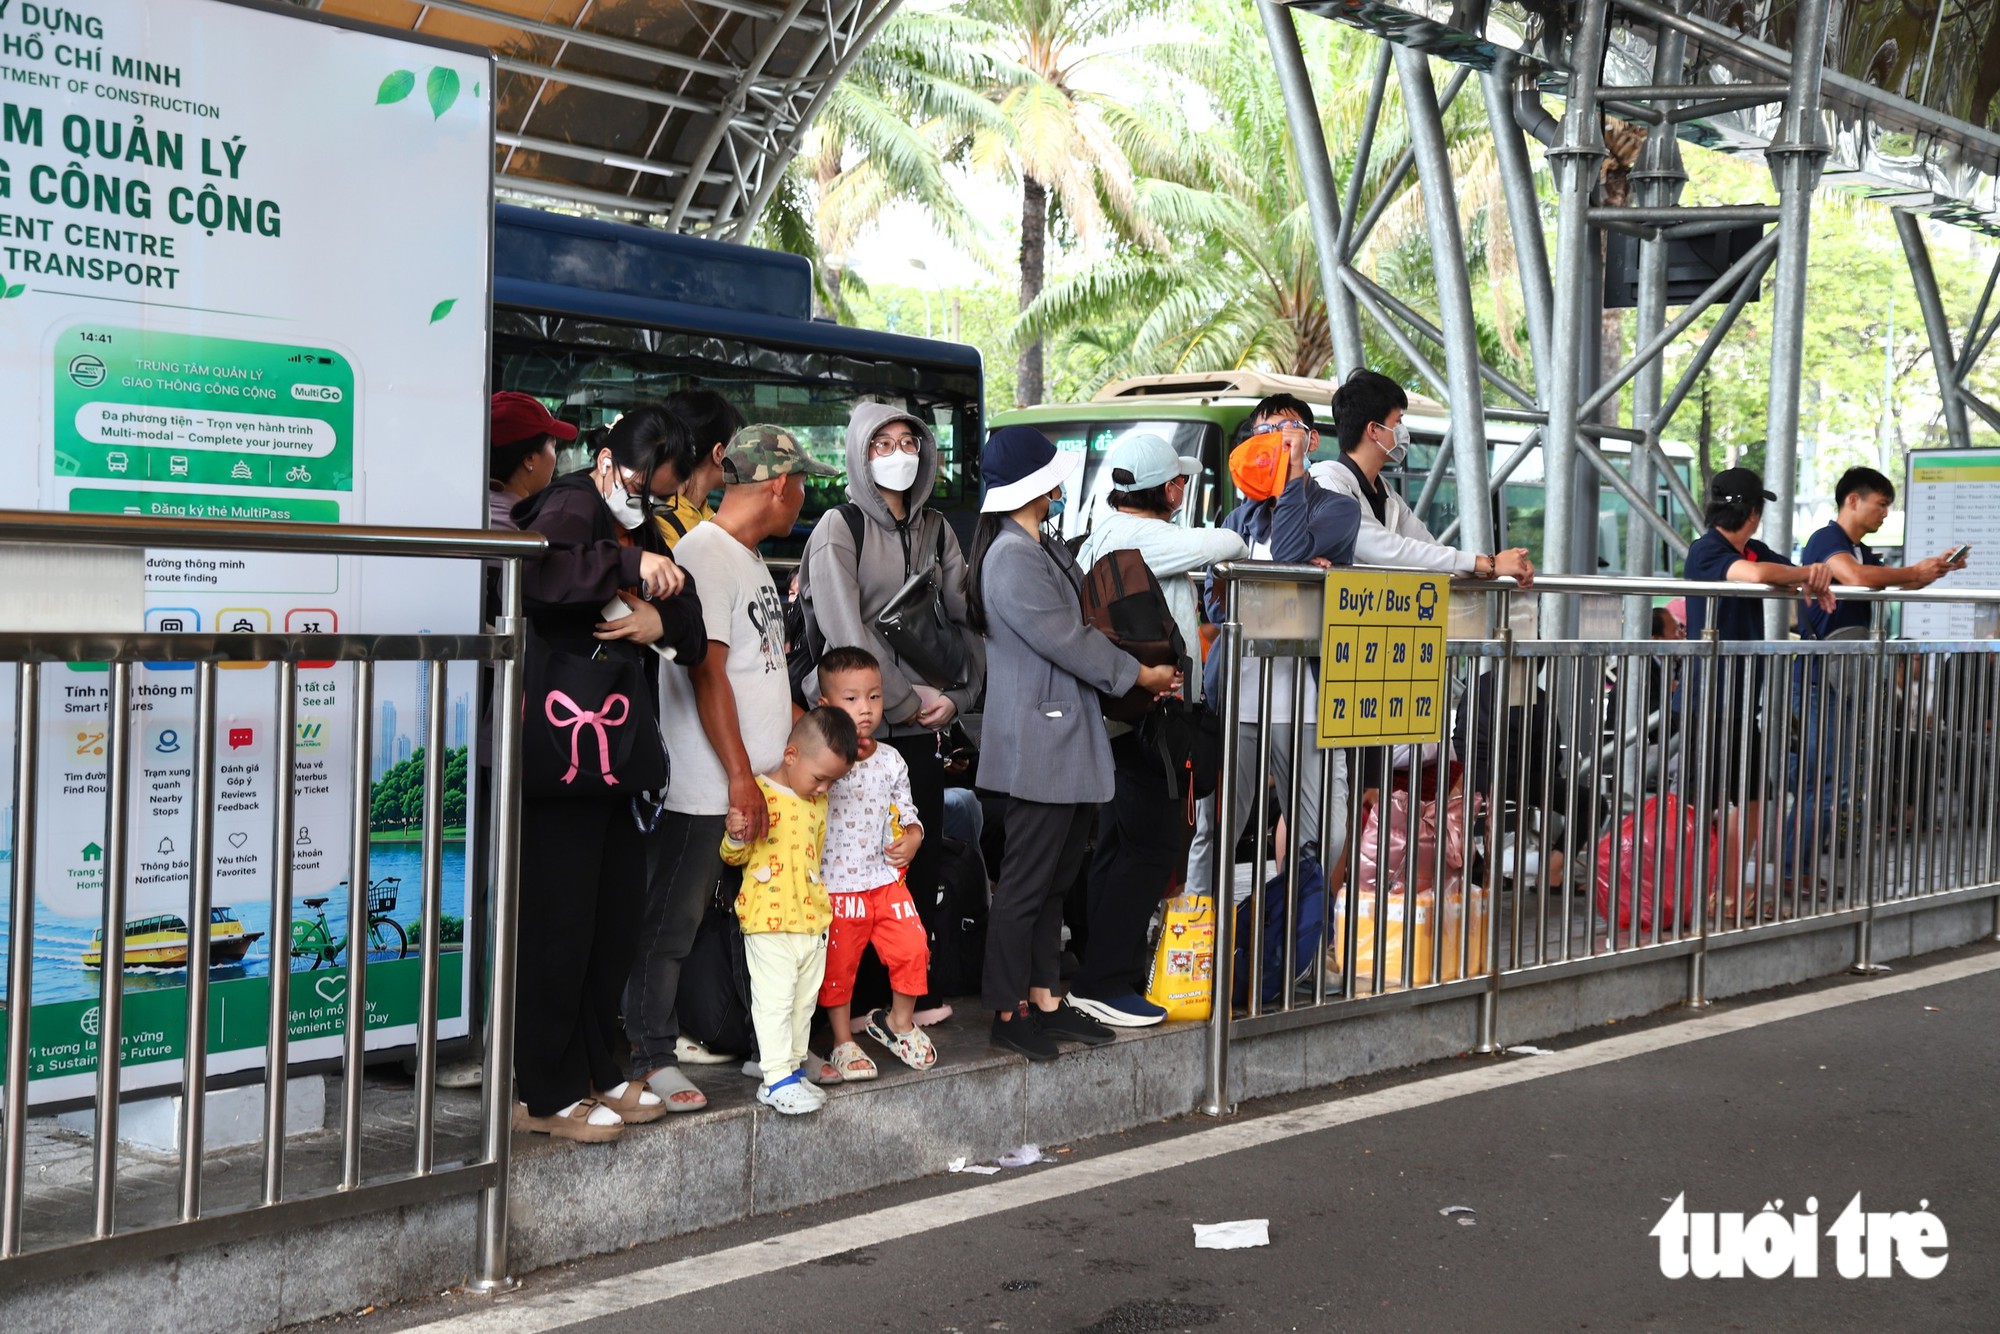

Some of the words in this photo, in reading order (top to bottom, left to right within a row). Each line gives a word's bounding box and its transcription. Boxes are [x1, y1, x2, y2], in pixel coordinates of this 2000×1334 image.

[22, 2, 104, 40] DỰNG
[4, 32, 44, 61] HỒ
[55, 44, 102, 73] CHÍ
[112, 55, 181, 88] MINH
[67, 79, 89, 95] OF
[95, 84, 220, 119] CONSTRUCTION
[62, 114, 183, 171] QUẢN
[201, 135, 247, 180] LÝ
[30, 161, 151, 219] CÔNG
[168, 183, 281, 238] CỘNG
[64, 223, 175, 259] CENTRE
[3, 247, 180, 289] TRANSPORT
[80, 332, 112, 344] 14:41
[135, 359, 179, 373] TRUNG
[183, 362, 209, 376] TÂM
[212, 366, 247, 379] QUẢN
[250, 369, 263, 380] LÝ
[121, 376, 153, 389] GIAO
[156, 378, 201, 393] THÔNG
[204, 382, 239, 396] CÔNG
[242, 385, 277, 400] CỘNG
[102, 410, 118, 420] Đa
[122, 412, 167, 427] phương
[170, 415, 193, 428] tiện
[207, 418, 232, 431] Trọn
[235, 422, 255, 432] vẹn
[258, 421, 285, 433] hành
[288, 424, 313, 435] trình
[101, 426, 174, 440] Multi-modal
[188, 433, 243, 446] Complete
[246, 438, 270, 448] your
[272, 439, 313, 452] journey
[151, 503, 186, 516] Đăng
[189, 504, 204, 517] ký
[207, 506, 228, 517] thẻ
[231, 507, 291, 519] MultiPass
[146, 558, 182, 570] đường
[185, 558, 216, 570] thông
[219, 559, 245, 569] minh
[155, 574, 181, 582] route
[184, 573, 218, 584] finding
[1339, 587, 1374, 617] Buýt
[1386, 589, 1411, 612] Bus
[1335, 642, 1350, 663] 04
[1365, 642, 1379, 663] 27
[1392, 643, 1406, 663] 28
[1420, 643, 1434, 663] 39
[65, 686, 96, 697] Tính
[138, 684, 177, 698] thông
[305, 681, 320, 692] tất
[322, 681, 336, 692] cả
[302, 697, 321, 706] See
[323, 696, 335, 706] all
[64, 702, 101, 713] Smart
[1332, 698, 1346, 719] 72
[1359, 697, 1378, 718] 102
[1389, 697, 1404, 717] 171
[1416, 696, 1432, 717] 172
[144, 769, 167, 778] Trạm
[168, 768, 191, 777] xung
[220, 764, 244, 774] Đánh
[246, 763, 259, 774] giá
[226, 777, 245, 787] Góp
[295, 773, 328, 782] aterbus
[63, 785, 84, 794] Find
[87, 785, 106, 793] Rou
[152, 781, 181, 791] quanh
[303, 785, 329, 794] Ticket
[149, 794, 183, 804] Nearby
[221, 790, 257, 799] Reviews
[152, 807, 179, 817] Stops
[217, 802, 259, 812] Feedback
[235, 854, 257, 863] thích
[141, 861, 170, 871] Thông
[172, 860, 190, 869] báo
[292, 862, 320, 871] ccount
[67, 868, 96, 878] Trang
[216, 867, 256, 877] Favorites
[135, 873, 189, 884] Notification
[288, 1011, 306, 1023] iện
[309, 1007, 323, 1020] lợi
[326, 1003, 344, 1016] mỗ
[288, 1020, 331, 1036] venient
[368, 1013, 389, 1024] Day
[41, 1042, 80, 1057] tương
[85, 1040, 97, 1050] la
[132, 1031, 164, 1044] vững
[36, 1064, 44, 1073] a
[131, 1045, 172, 1059] Future
